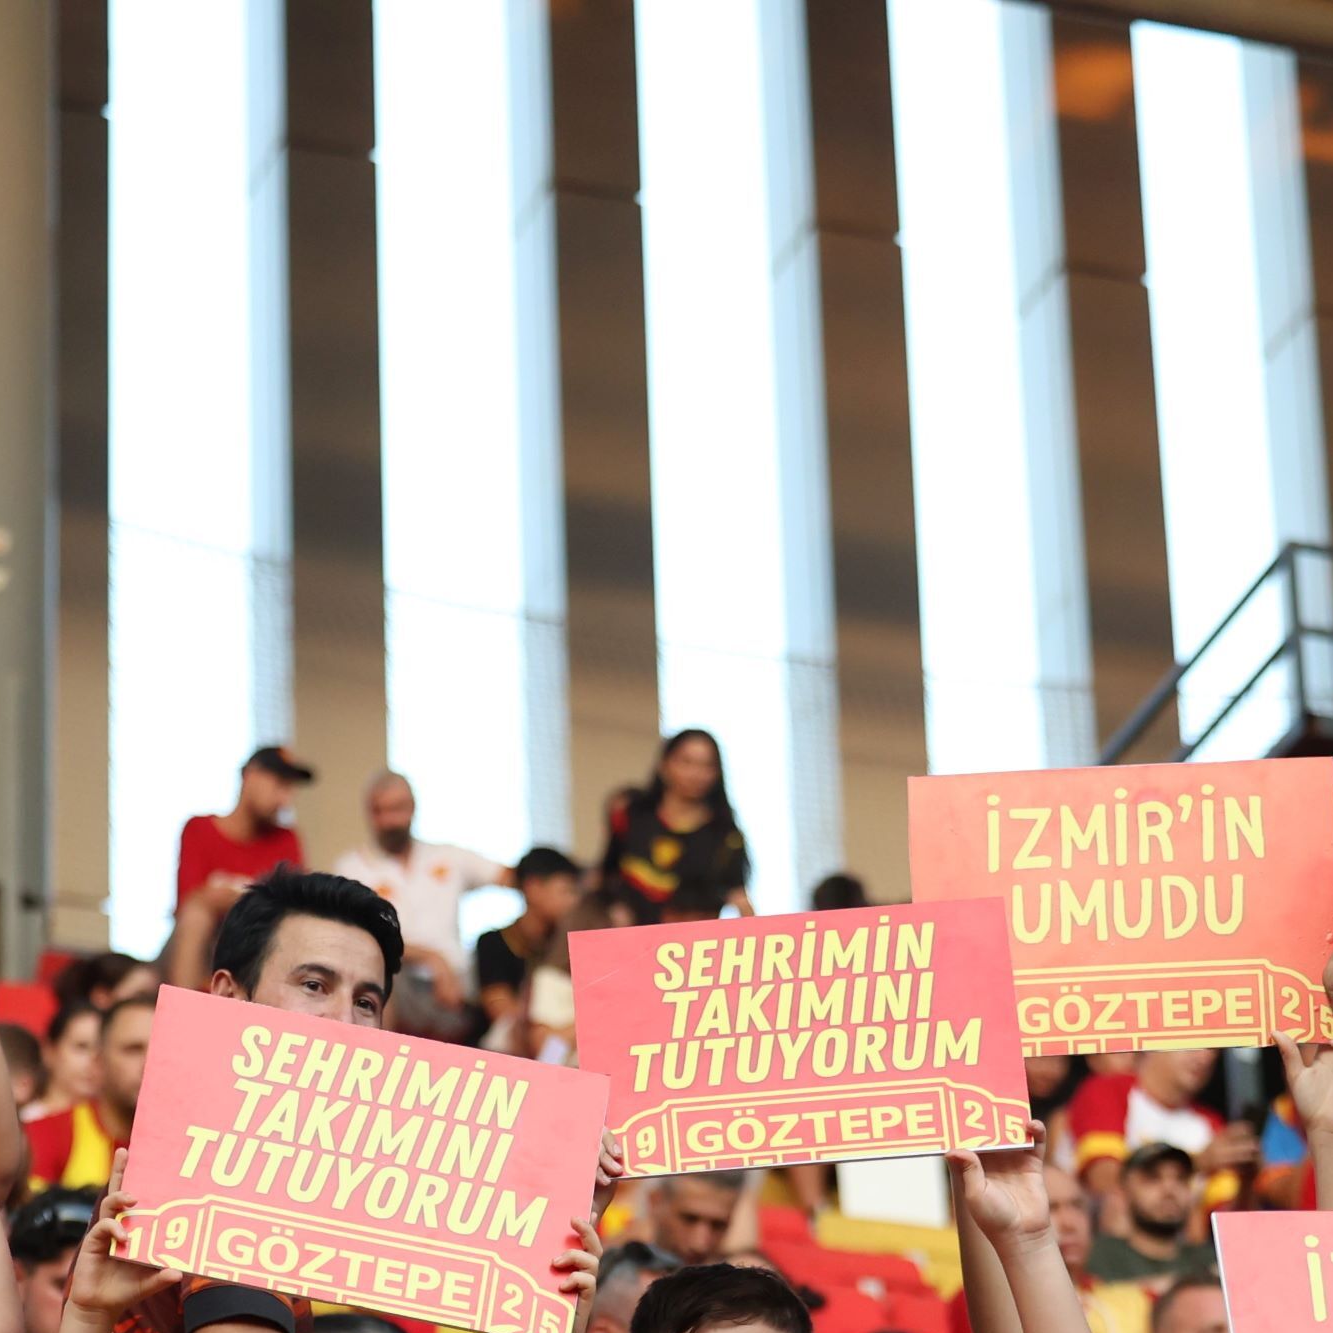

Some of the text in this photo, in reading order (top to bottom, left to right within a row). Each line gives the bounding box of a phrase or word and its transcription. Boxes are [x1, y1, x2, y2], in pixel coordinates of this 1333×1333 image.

[987, 784, 1265, 873] İZMİR'İN
[1012, 874, 1244, 945] UMUDU
[662, 972, 934, 1039] TAKIMINI
[1017, 985, 1254, 1034] GÖZTEPE
[629, 1018, 983, 1093] TUTUYORUM
[233, 1079, 515, 1184] TAKIMINI
[686, 1103, 936, 1154] GÖZTEPE
[179, 1126, 549, 1249] TUTUYORUM
[215, 1227, 478, 1311] GÖZTEPE
